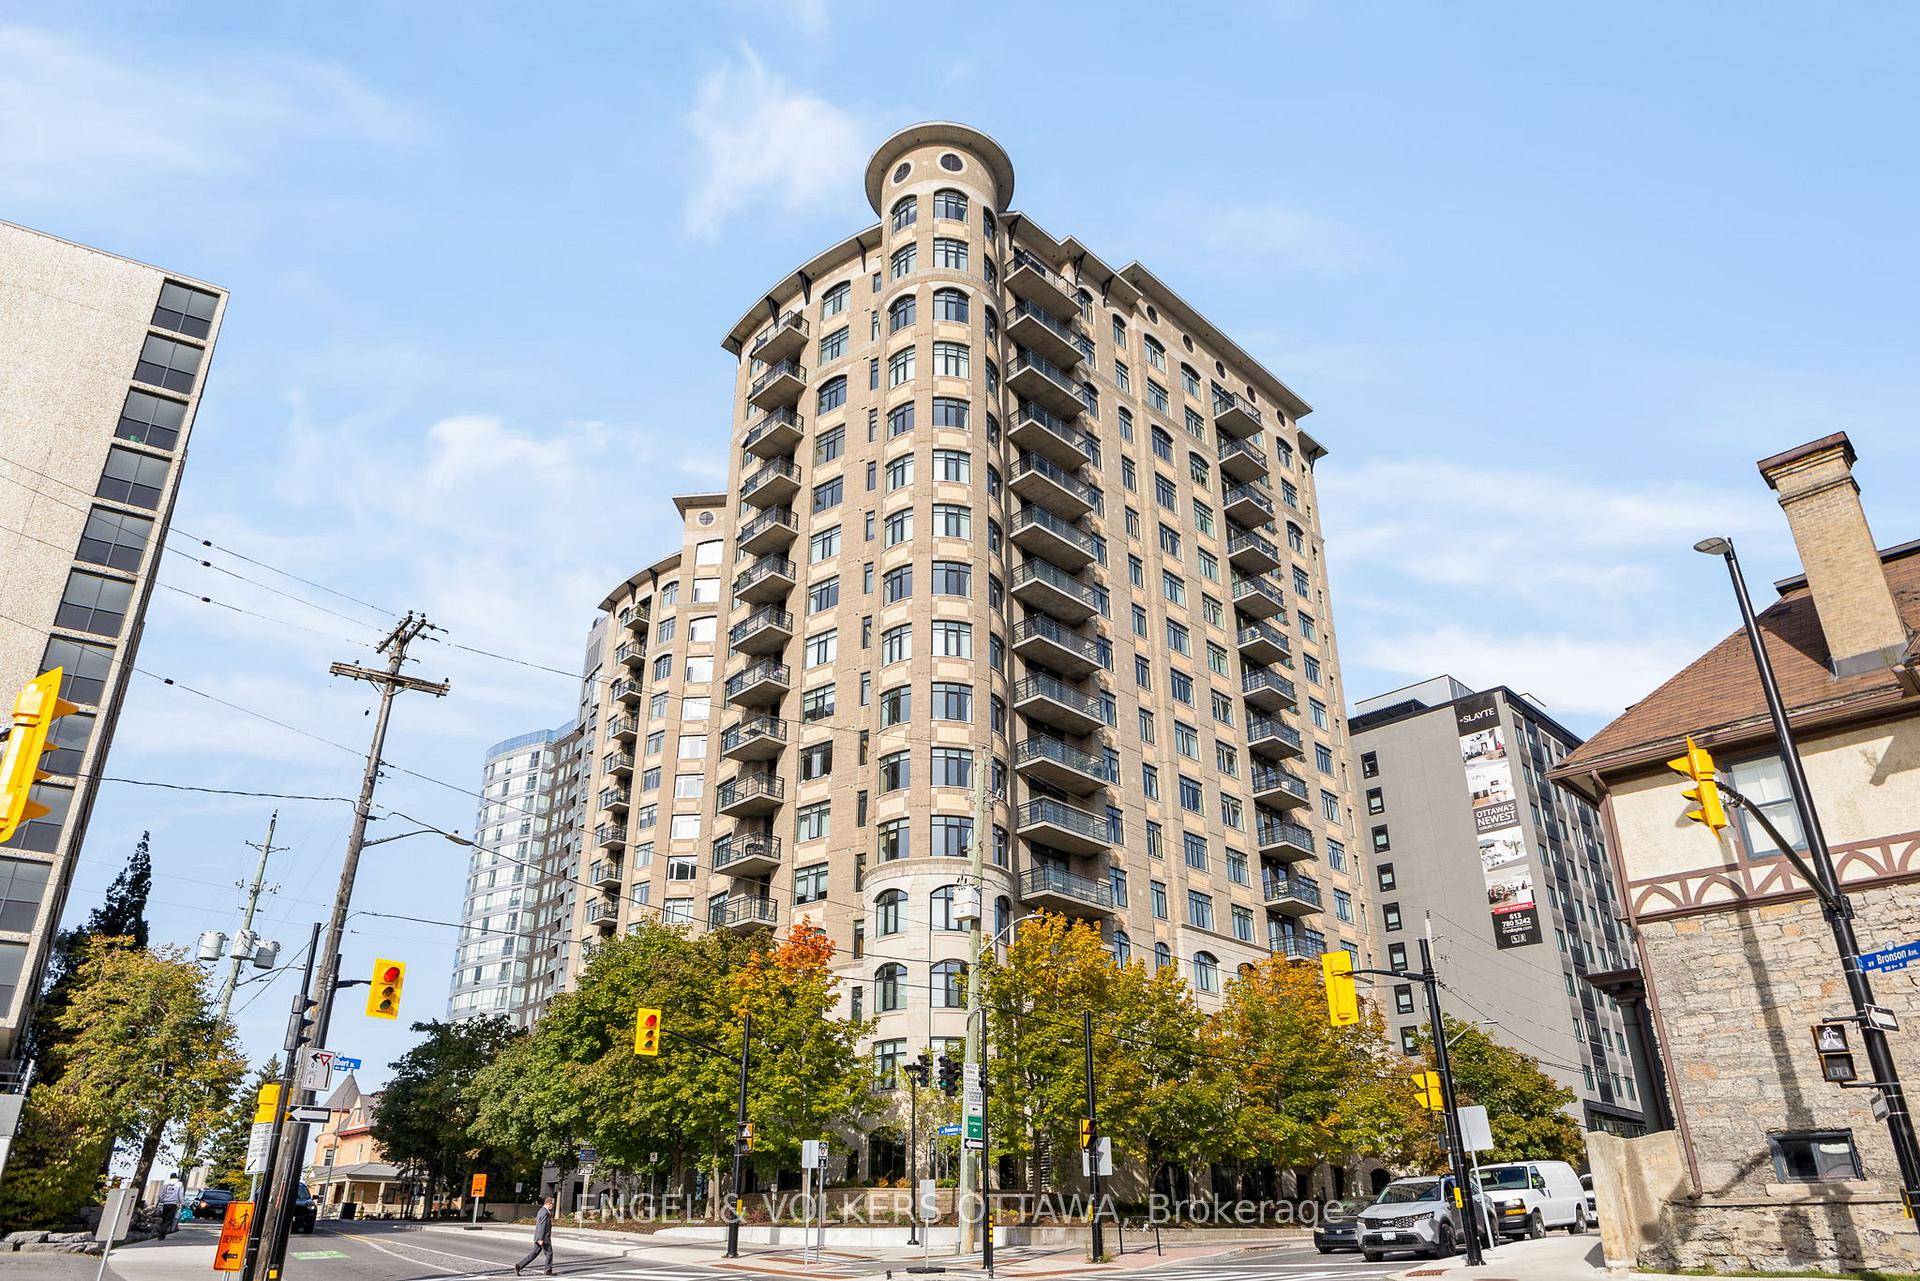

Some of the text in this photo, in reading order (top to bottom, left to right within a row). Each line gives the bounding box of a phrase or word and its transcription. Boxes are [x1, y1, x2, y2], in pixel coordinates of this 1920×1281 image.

[1476, 803, 1515, 818] OTTAWA'S
[1477, 810, 1516, 827] NEWEST
[1876, 950, 1907, 965] Bronson
